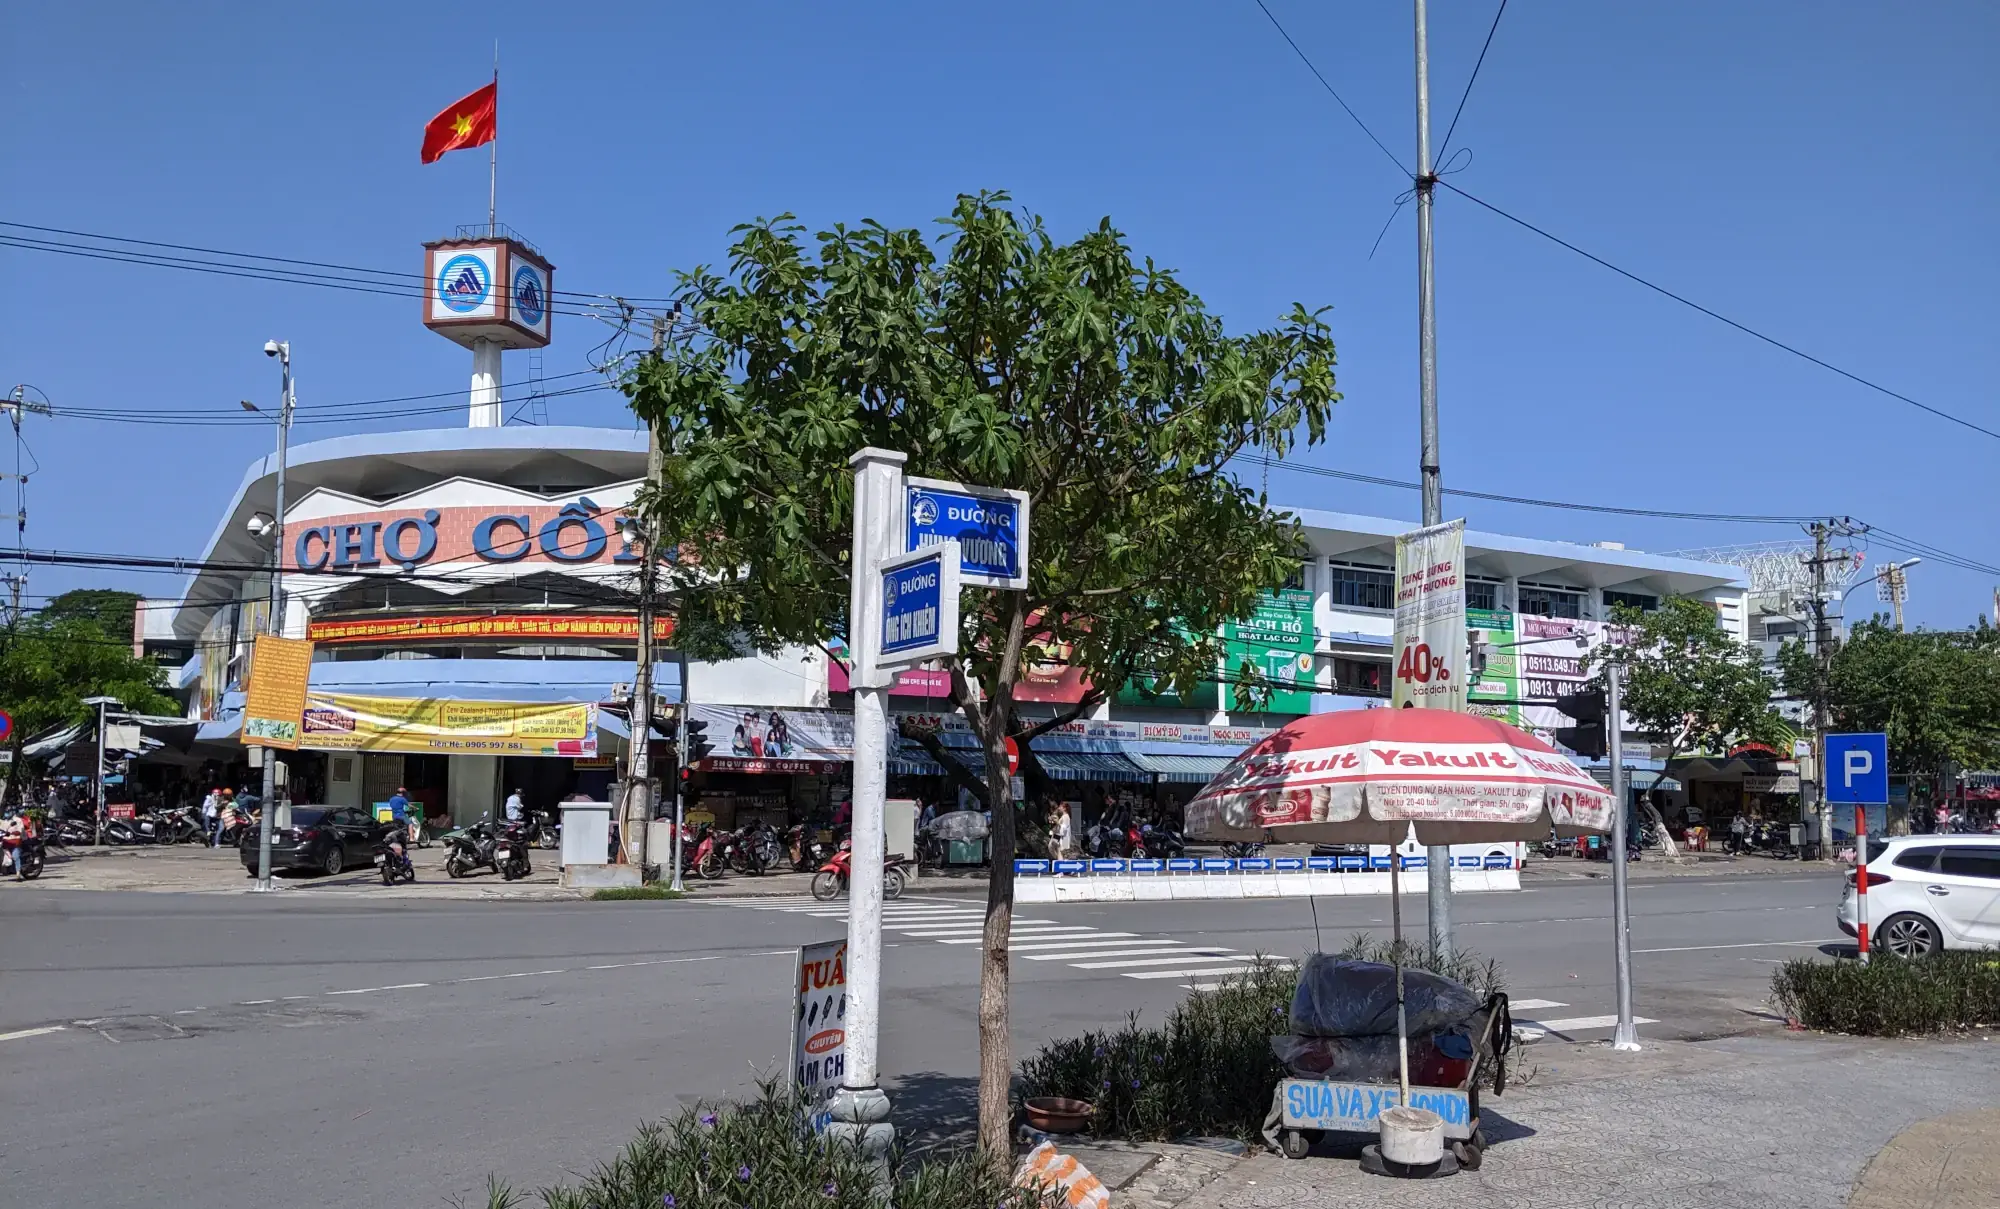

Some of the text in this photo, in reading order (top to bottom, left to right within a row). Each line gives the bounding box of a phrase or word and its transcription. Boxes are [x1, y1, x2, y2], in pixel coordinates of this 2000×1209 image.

[948, 505, 1010, 527] ĐƯỜNG
[295, 509, 440, 572] CHỢ
[961, 537, 1007, 566] VƯƠNG
[901, 571, 936, 595] ĐƯỜNG
[886, 602, 936, 644] ÔNG ÍCH KHIÊM
[1430, 684, 1446, 696] dịch
[1450, 685, 1459, 695] vụ
[428, 740, 446, 748] Liên
[465, 740, 486, 749] 0905
[489, 741, 504, 749] 997
[507, 742, 523, 750] 881
[1213, 730, 1231, 741] NGỌC
[776, 761, 810, 770] COFFEE
[1246, 753, 1360, 777] Yakult
[1370, 749, 1518, 769] Yakult
[1844, 750, 1872, 788] P
[1406, 797, 1424, 806] 20-40
[1484, 787, 1511, 797] YAKULT
[1512, 788, 1532, 798] LADY
[1575, 791, 1602, 811] Yakult
